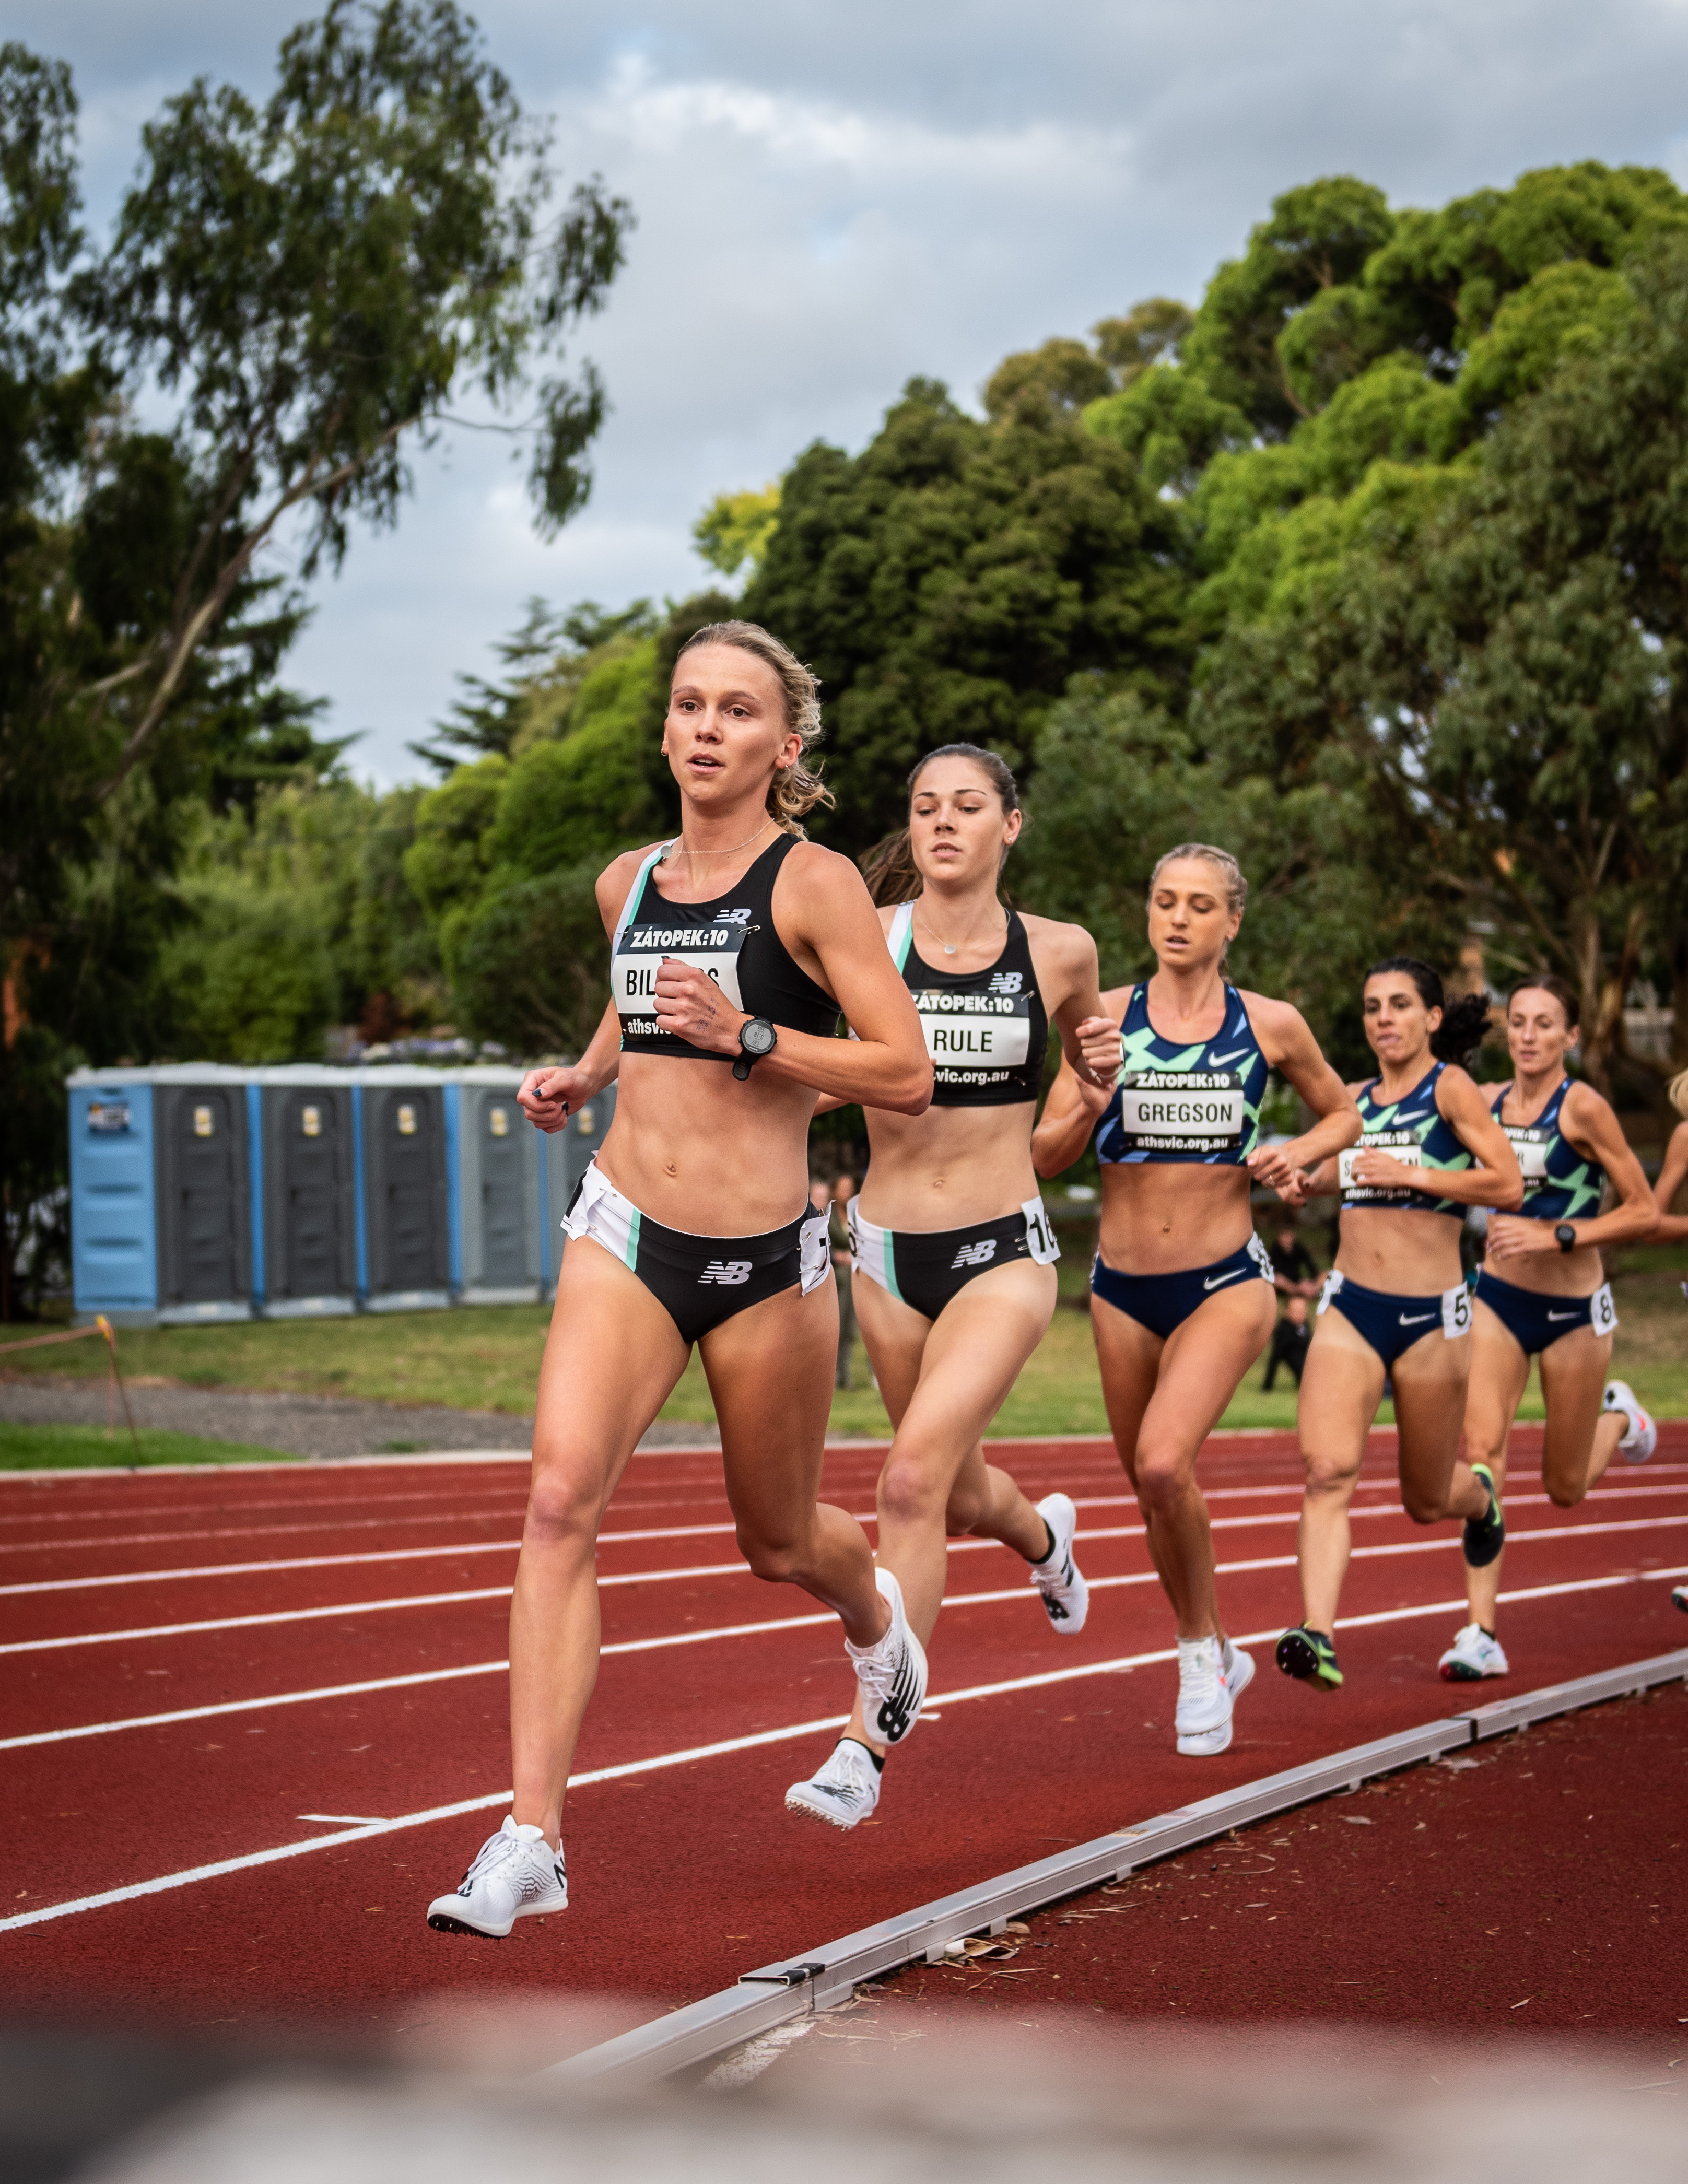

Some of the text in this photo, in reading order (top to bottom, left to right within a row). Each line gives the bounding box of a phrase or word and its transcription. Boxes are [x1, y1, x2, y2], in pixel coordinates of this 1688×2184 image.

[630, 926, 729, 948] ZÁTOPEK:10
[934, 1029, 992, 1052] RULE
[1136, 1070, 1230, 1088] ZÁTOPEK:10
[1138, 1103, 1232, 1122] GREGSON
[1136, 1135, 1228, 1152] athsvic.org.au
[1455, 1293, 1469, 1327] 5
[1600, 1294, 1611, 1323] 8
